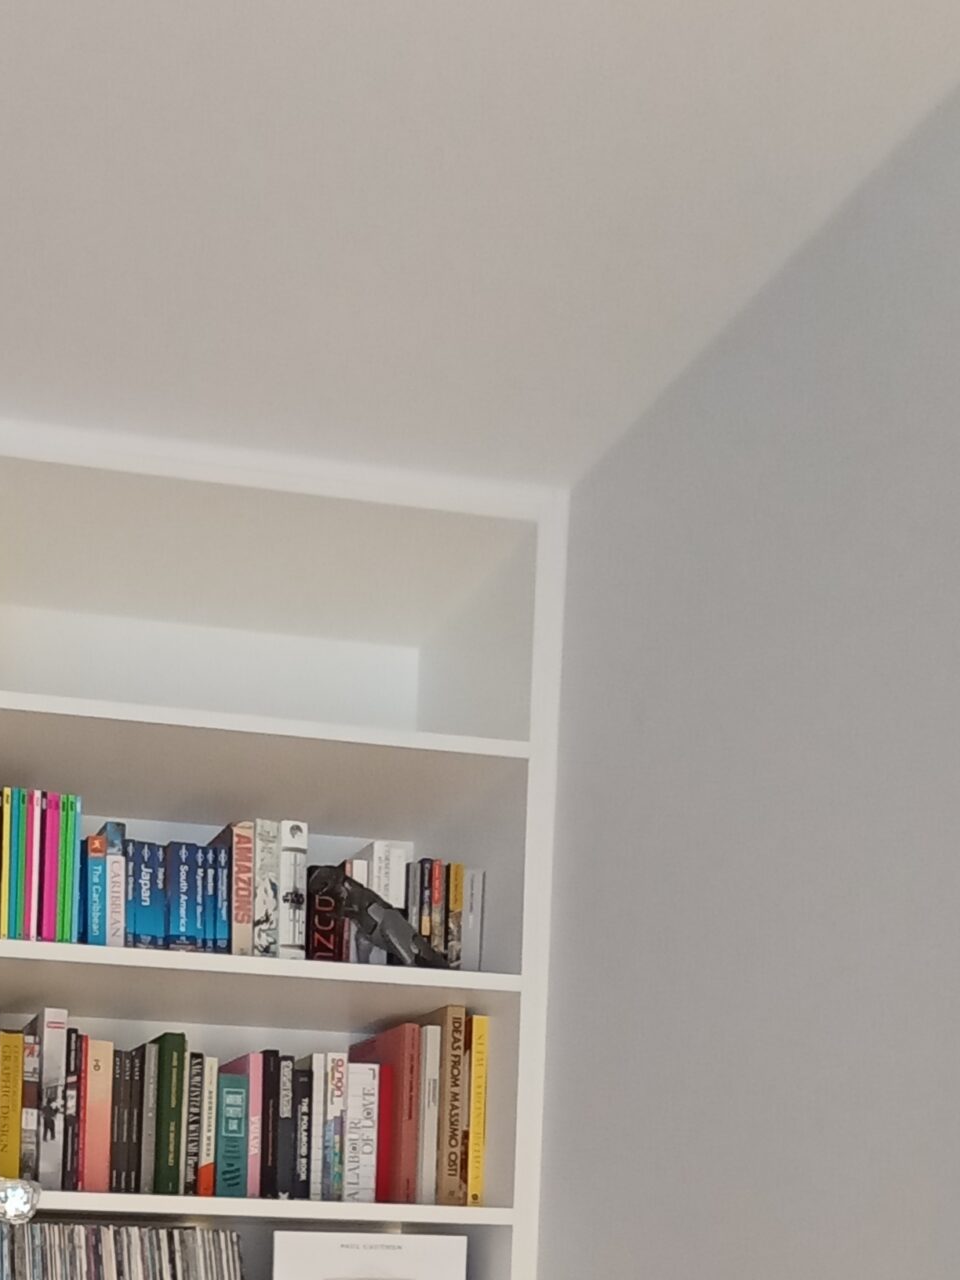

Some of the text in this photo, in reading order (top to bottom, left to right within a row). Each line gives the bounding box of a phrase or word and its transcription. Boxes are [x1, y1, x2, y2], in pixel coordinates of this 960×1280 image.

[91, 865, 103, 936] The Caribbean
[110, 860, 123, 938] CARIBBEAN
[139, 863, 154, 906] Japan
[178, 864, 189, 933] South America
[207, 868, 216, 896] Boston
[234, 833, 254, 925] AMAZONS
[0, 1044, 13, 1153] GRAPHIC DESIGN
[361, 1087, 376, 1156] OF LOVE
[447, 1016, 463, 1178] IDEAS FROM MASSIMO OSTI
[249, 1115, 260, 1155] VULVA
[299, 1097, 310, 1181] THE POLAROID BOOK
[346, 1119, 361, 1202] A LABOUR
